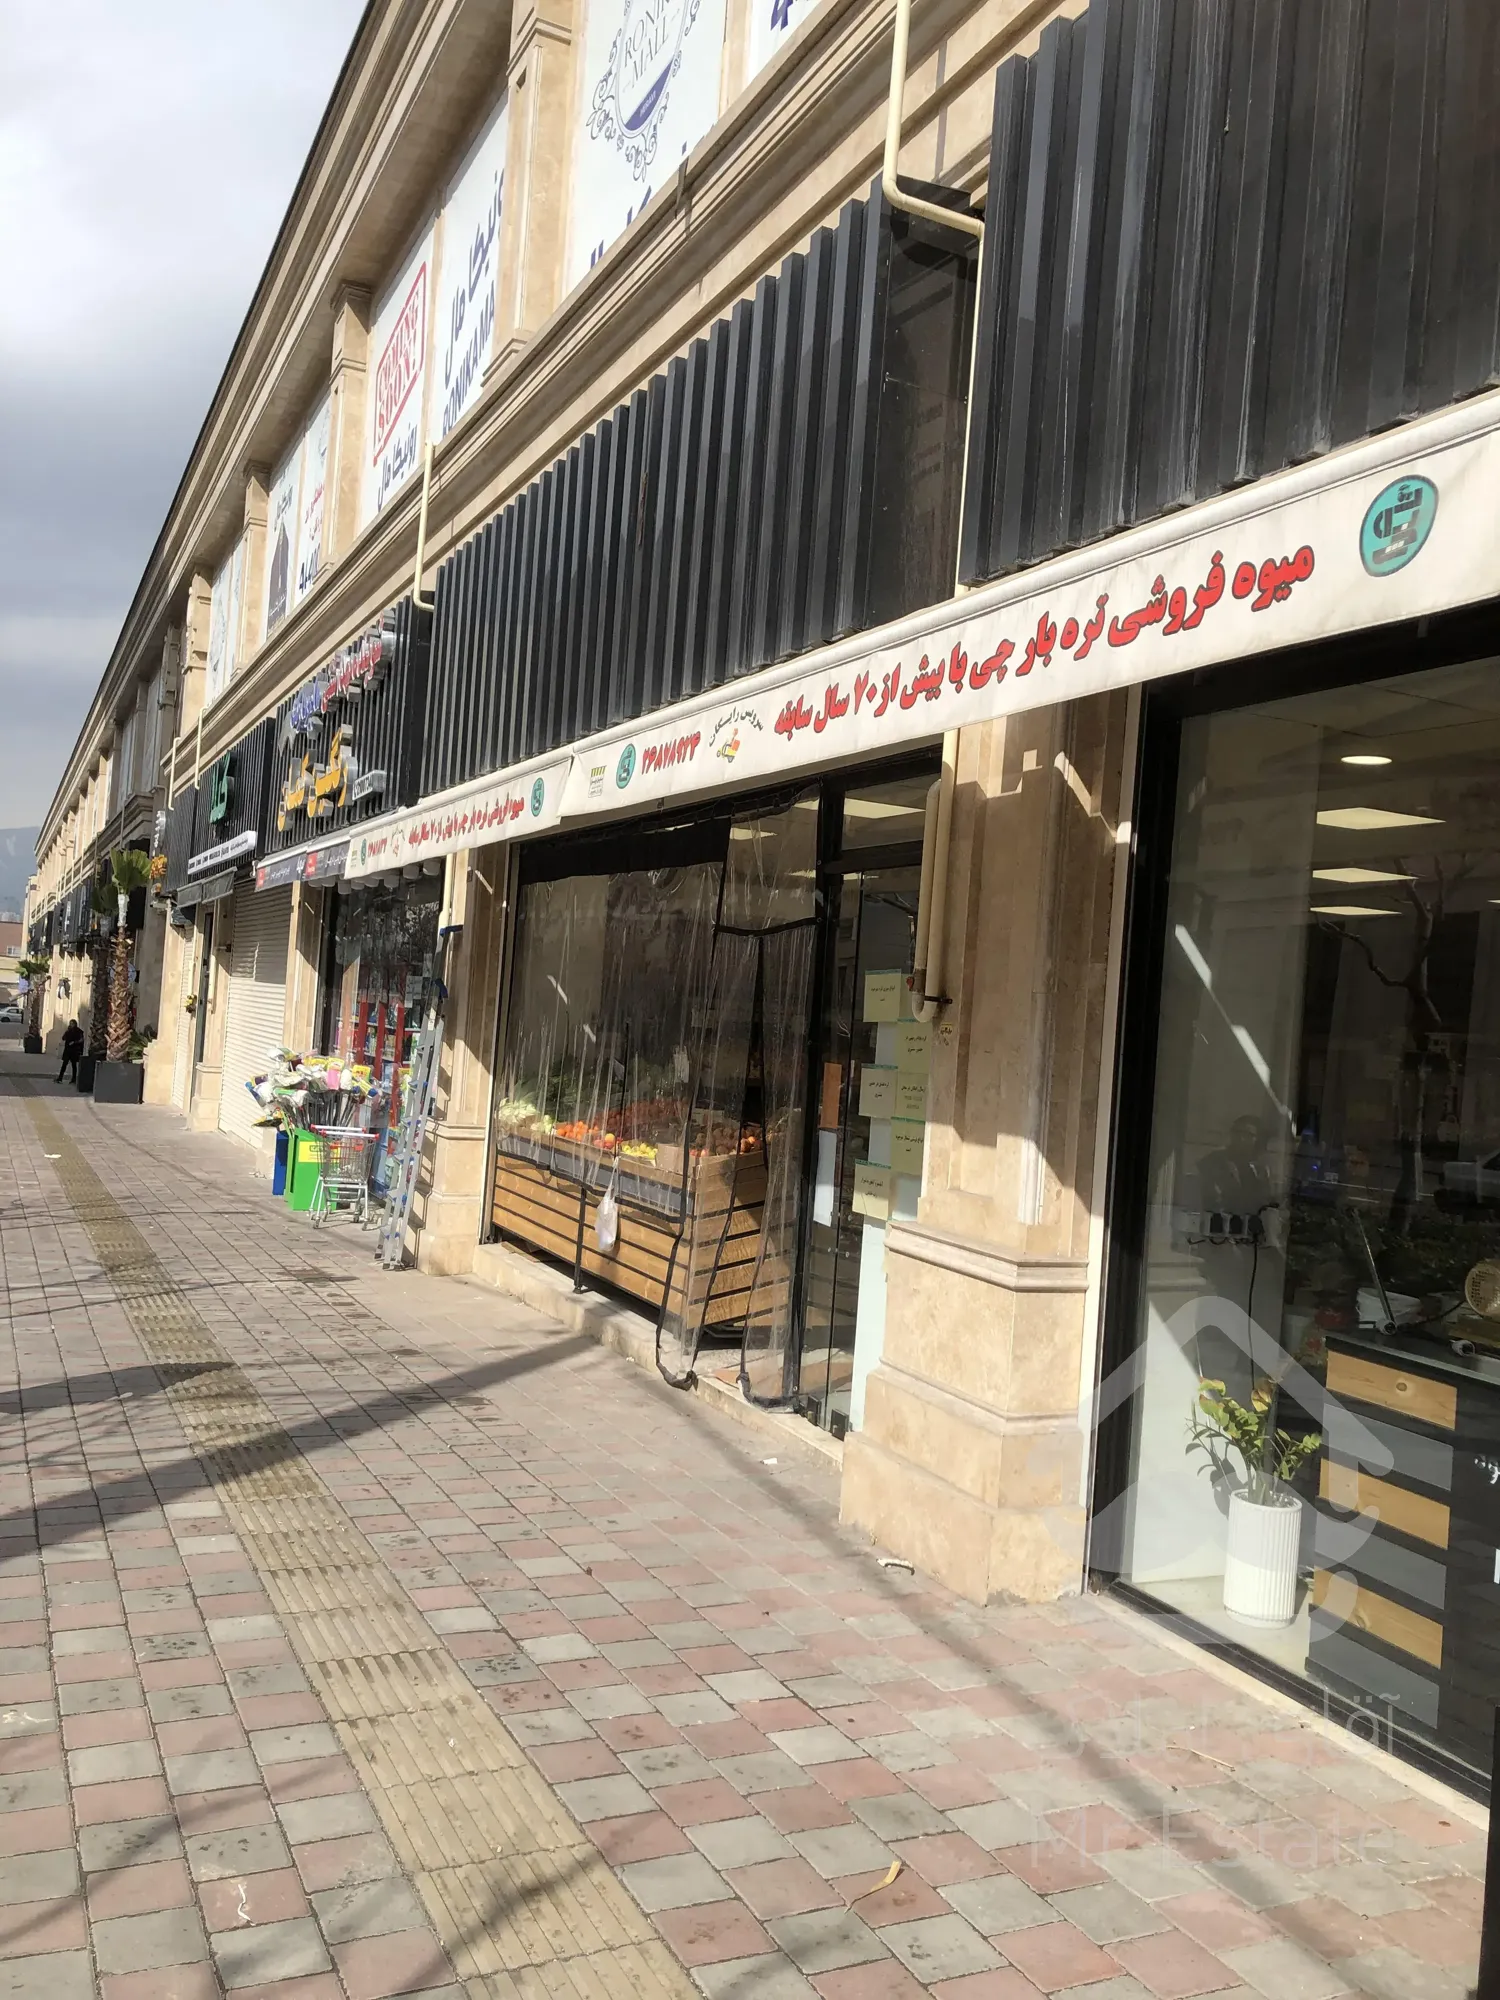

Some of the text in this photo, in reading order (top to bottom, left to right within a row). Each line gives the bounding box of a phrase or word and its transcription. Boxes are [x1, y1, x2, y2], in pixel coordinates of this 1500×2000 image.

[631, 15, 669, 89] MALL
[378, 290, 419, 401] COMING
[445, 285, 466, 391] مال
[377, 327, 417, 443] SOON!
[377, 421, 418, 513] رونیکا مال
[1107, 549, 1225, 647] فروشی
[1231, 544, 1315, 612] میوه
[1015, 611, 1057, 676] بار
[1060, 593, 1109, 661] تره
[873, 661, 902, 718] از
[900, 653, 943, 710] بیش
[949, 641, 968, 692] با
[969, 637, 1016, 689] چی
[774, 693, 813, 742] سابقه
[813, 682, 850, 734] سال
